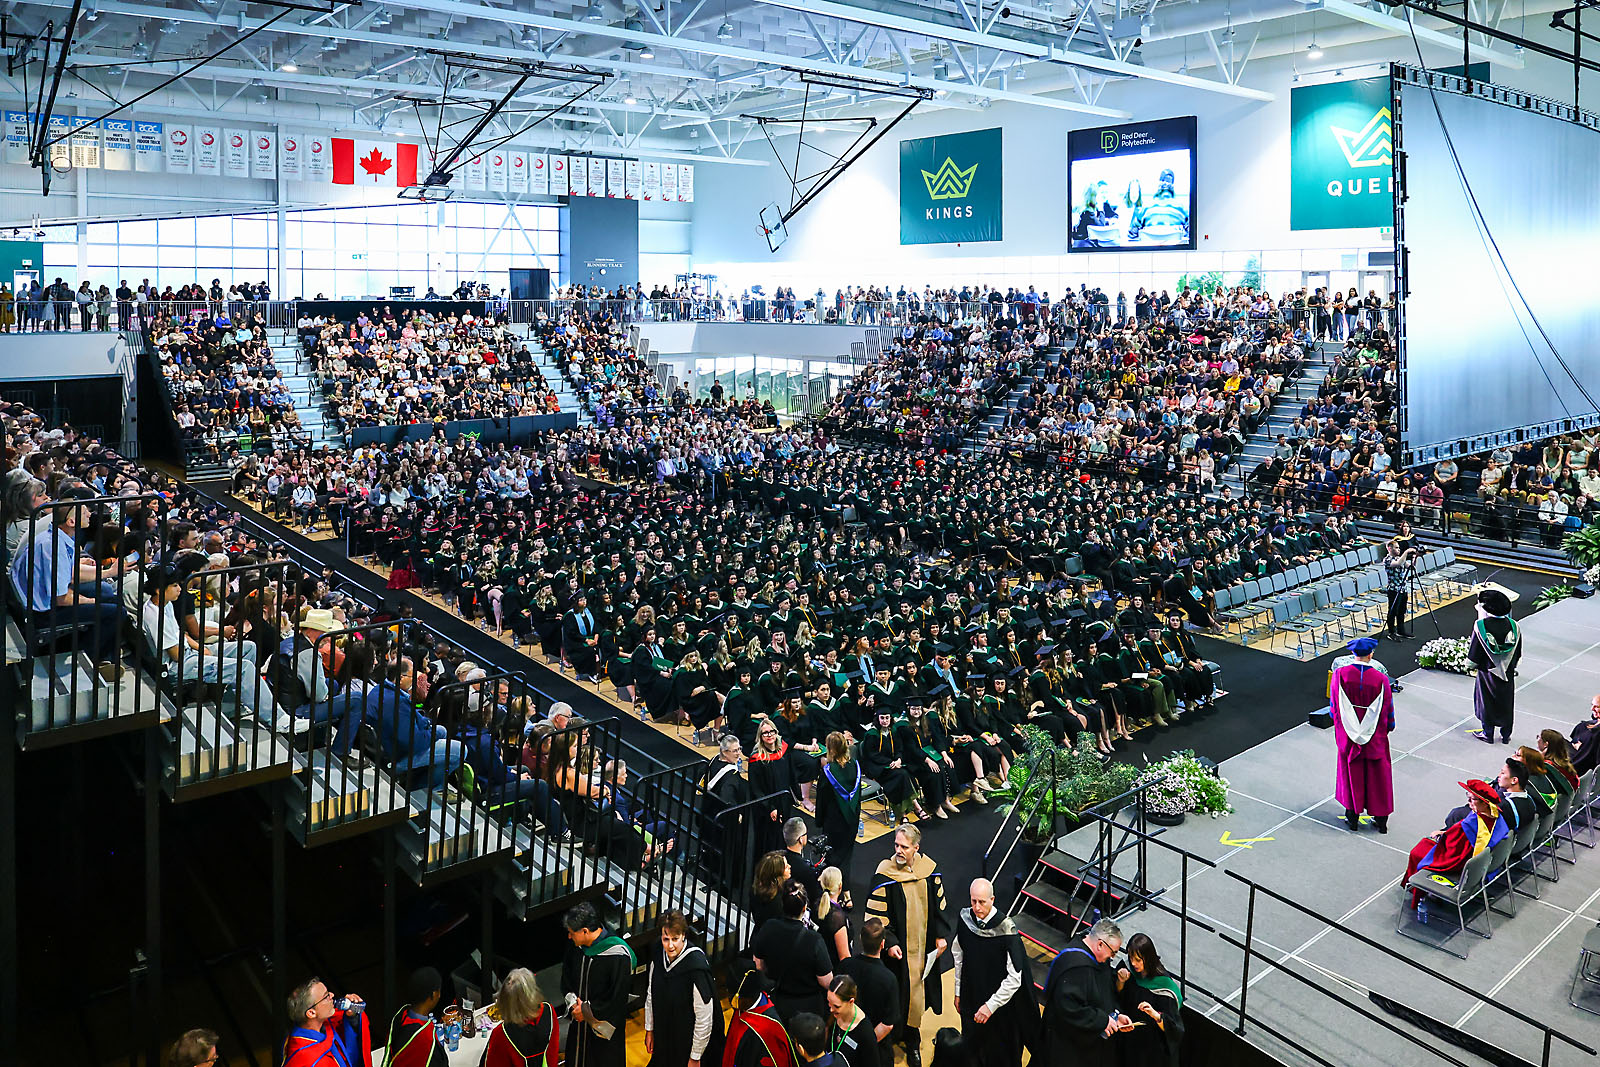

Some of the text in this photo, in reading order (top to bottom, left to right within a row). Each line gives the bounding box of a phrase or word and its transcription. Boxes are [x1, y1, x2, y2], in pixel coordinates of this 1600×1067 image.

[107, 121, 128, 130] acac
[138, 124, 158, 132] acac
[1122, 137, 1156, 147] Polytechnic
[926, 205, 972, 220] KINGS
